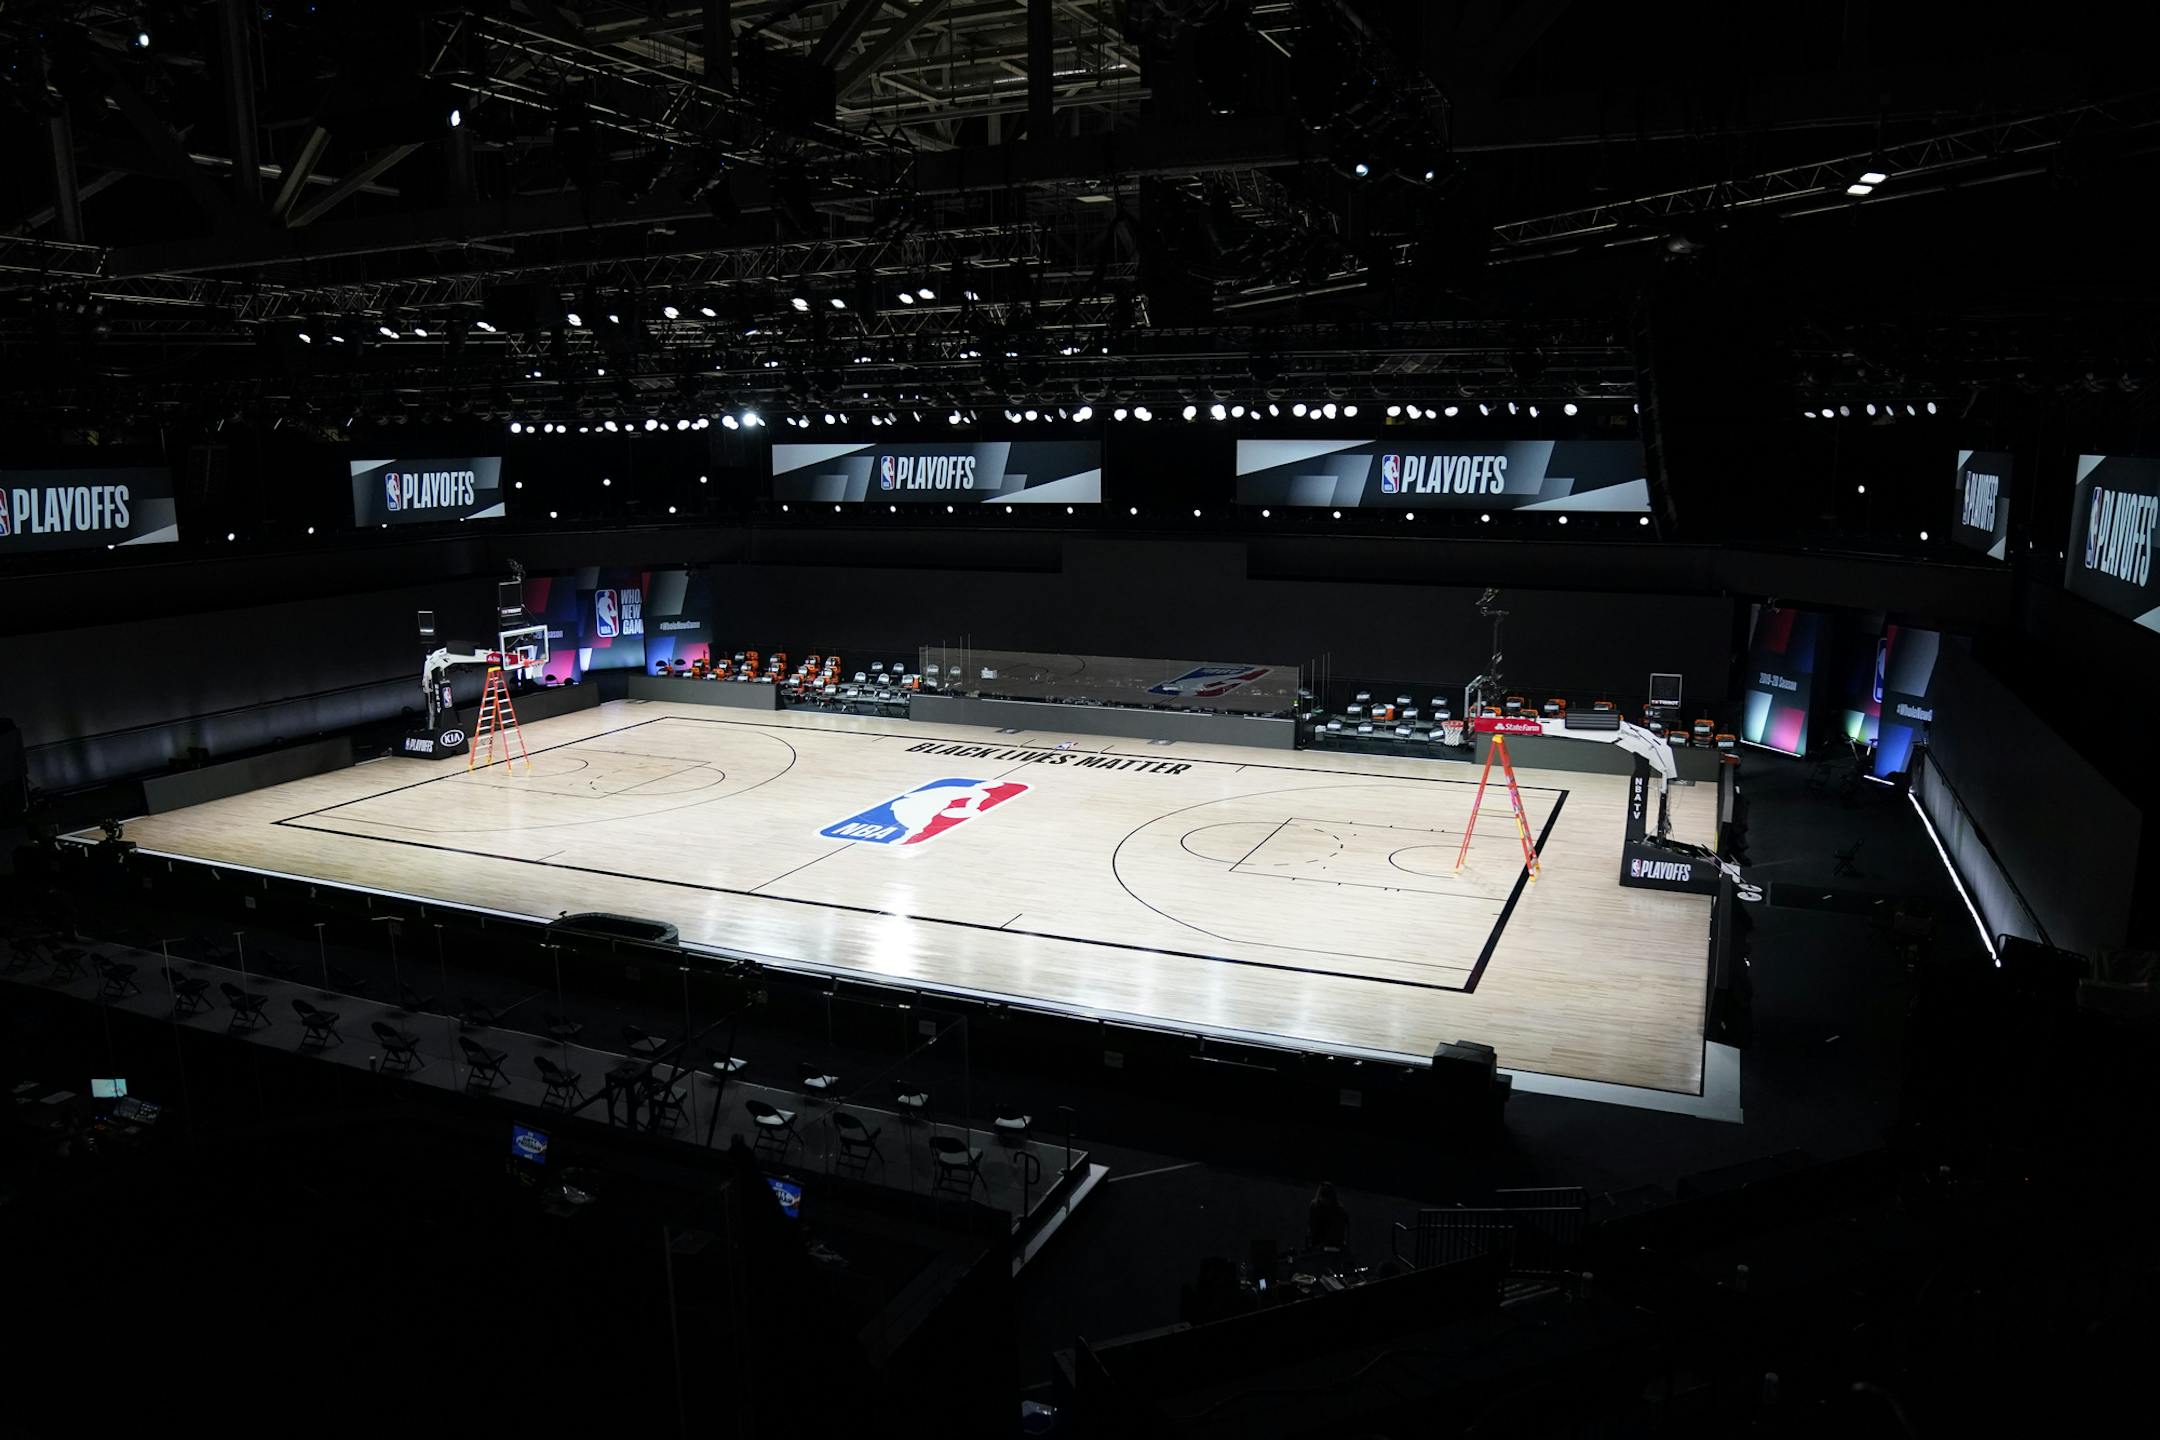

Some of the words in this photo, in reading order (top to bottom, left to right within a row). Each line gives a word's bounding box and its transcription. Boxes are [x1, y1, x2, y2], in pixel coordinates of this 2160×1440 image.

[900, 456, 976, 490] PLAYOFFS
[1401, 455, 1508, 494] PLAYOFFS
[403, 471, 475, 509] PLAYOFFS
[1970, 473, 1998, 532] PLAYOFFS
[12, 485, 130, 534] PLAYOFFS
[2094, 490, 2158, 587] PLAYOFFS
[621, 589, 642, 604] WHO
[622, 604, 641, 619] NEW
[443, 733, 461, 745] KIA
[907, 742, 996, 759] BLACK
[993, 749, 1077, 765] LIVES
[1074, 756, 1192, 775] MATTER
[1634, 777, 1643, 801] NBA
[1633, 803, 1641, 820] TV
[832, 822, 898, 840] NBA
[1641, 860, 1691, 882] PLAYOFFS
